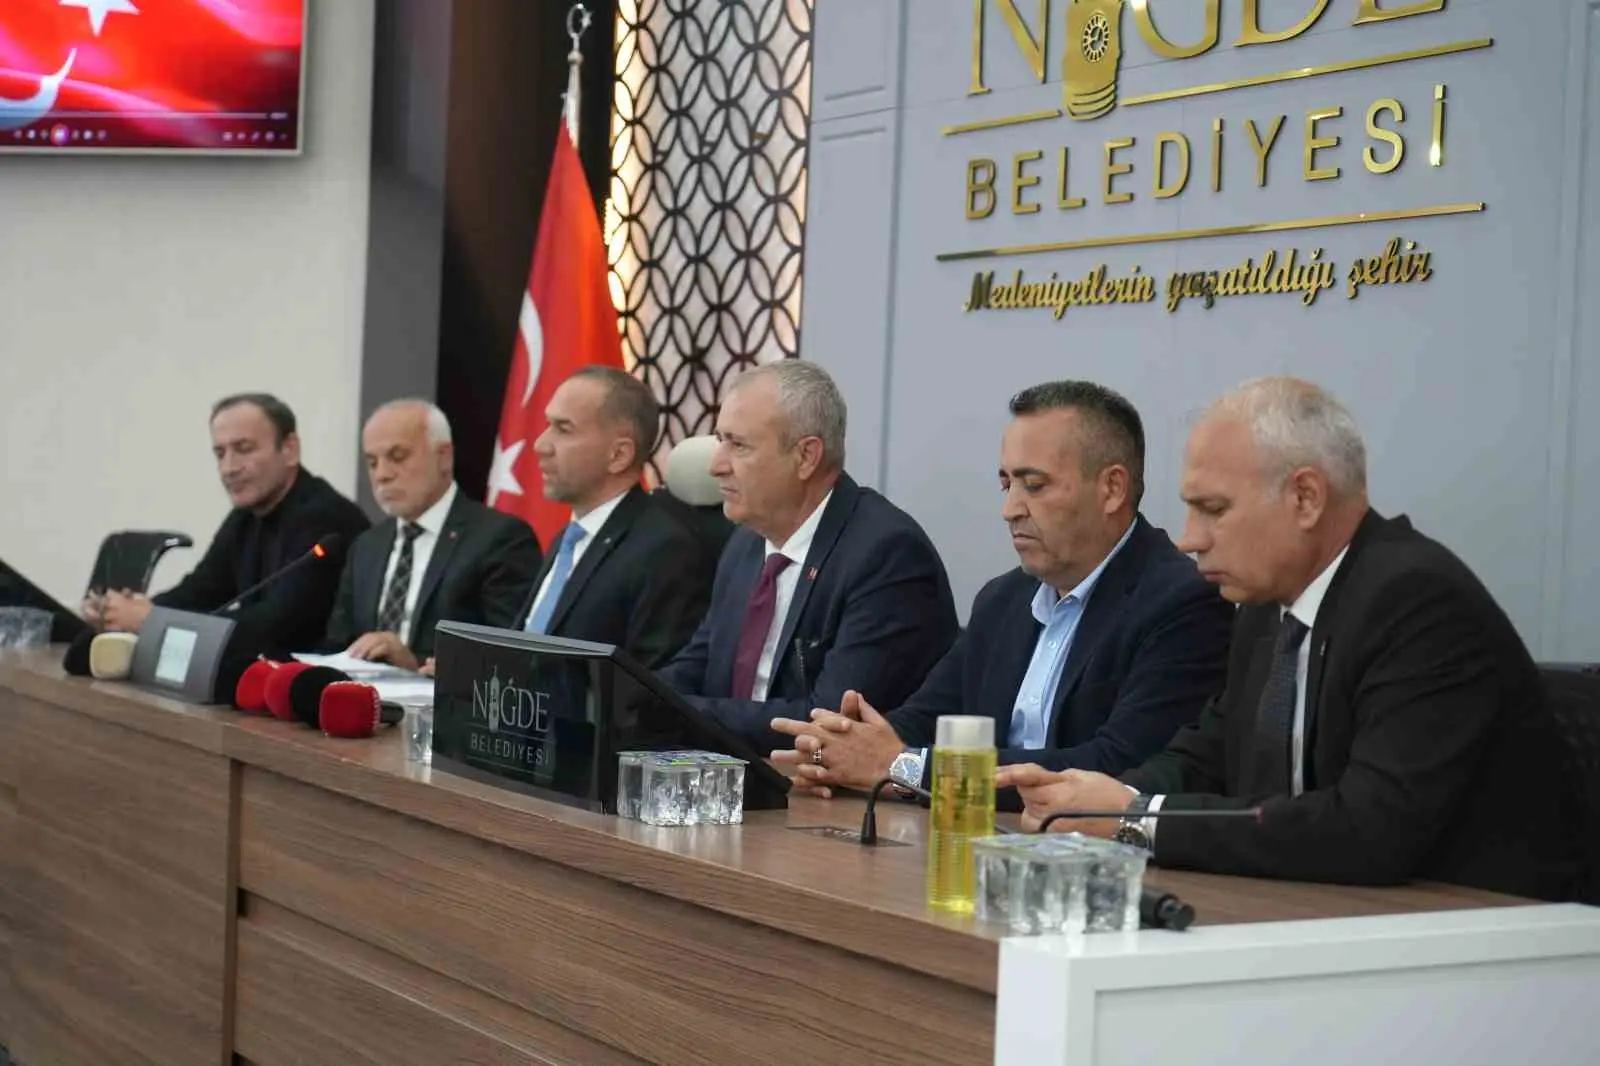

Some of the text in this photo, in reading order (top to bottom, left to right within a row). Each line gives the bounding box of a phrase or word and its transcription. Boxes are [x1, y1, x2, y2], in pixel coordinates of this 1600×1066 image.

[965, 84, 1447, 220] BELEDİYESİ
[963, 263, 1156, 320] Medeniyetlerin
[1347, 236, 1433, 300] şehir
